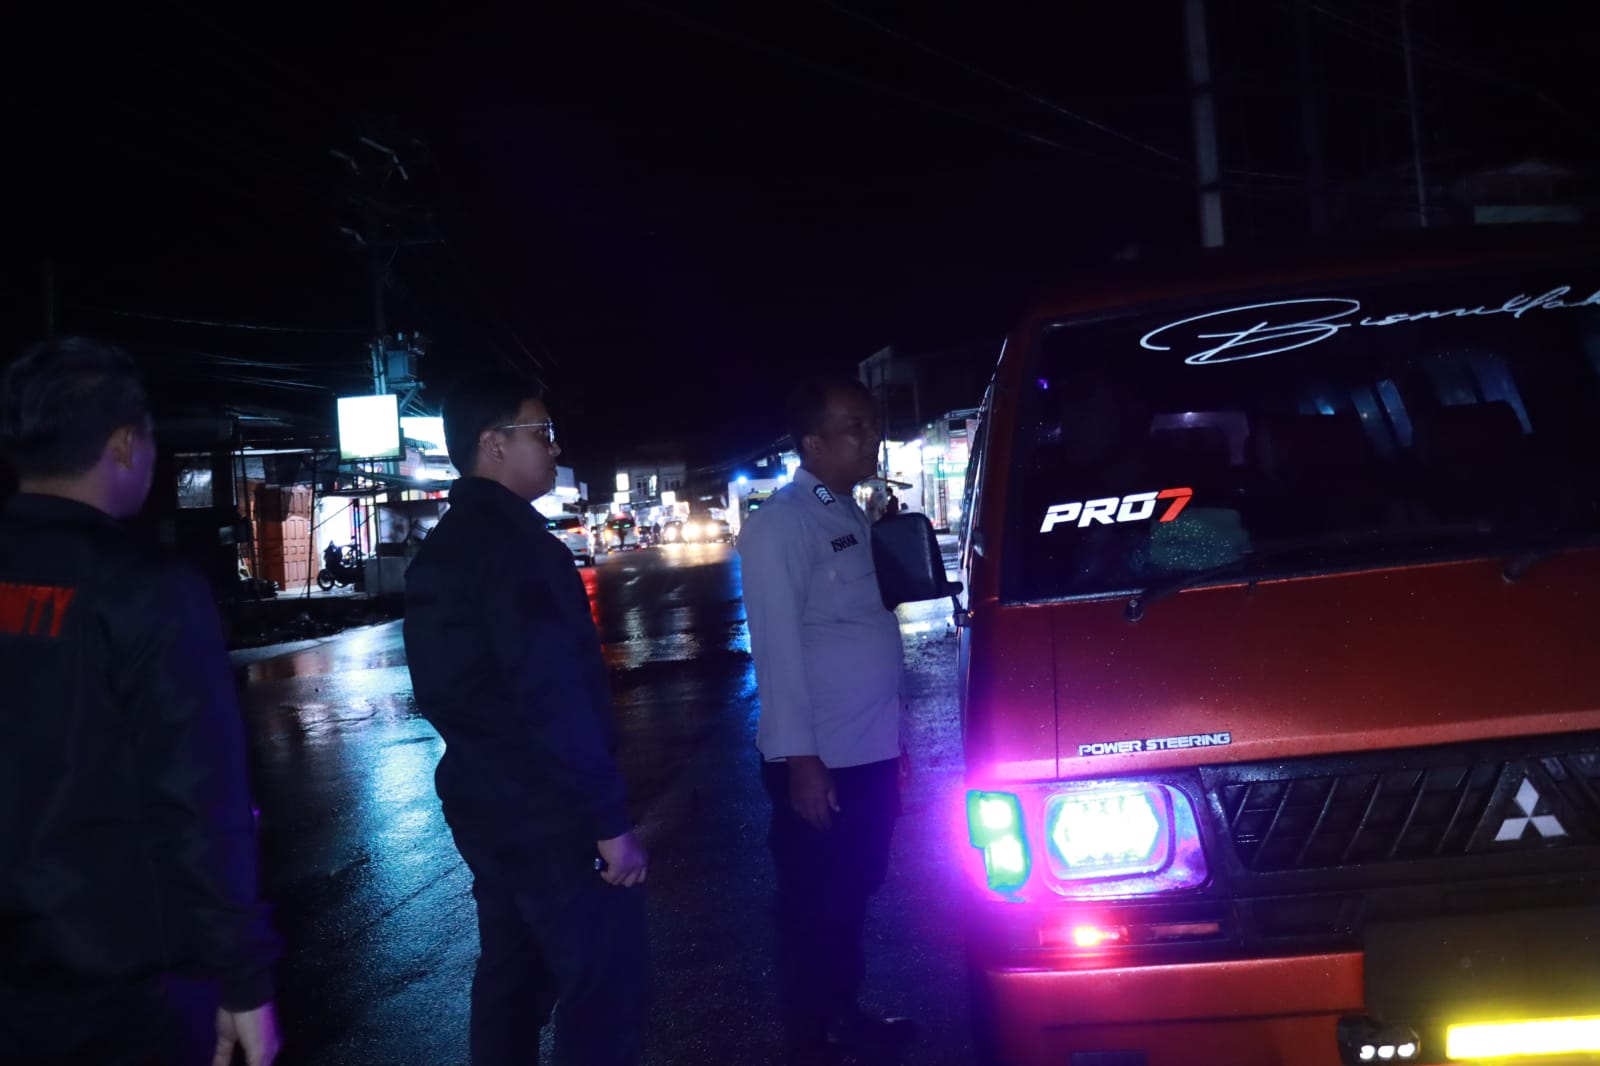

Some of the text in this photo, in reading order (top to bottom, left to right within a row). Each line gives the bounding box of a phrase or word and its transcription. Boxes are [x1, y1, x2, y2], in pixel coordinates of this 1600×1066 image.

[1040, 487, 1193, 533] PRO7
[1078, 732, 1231, 756] POWER STEERING
